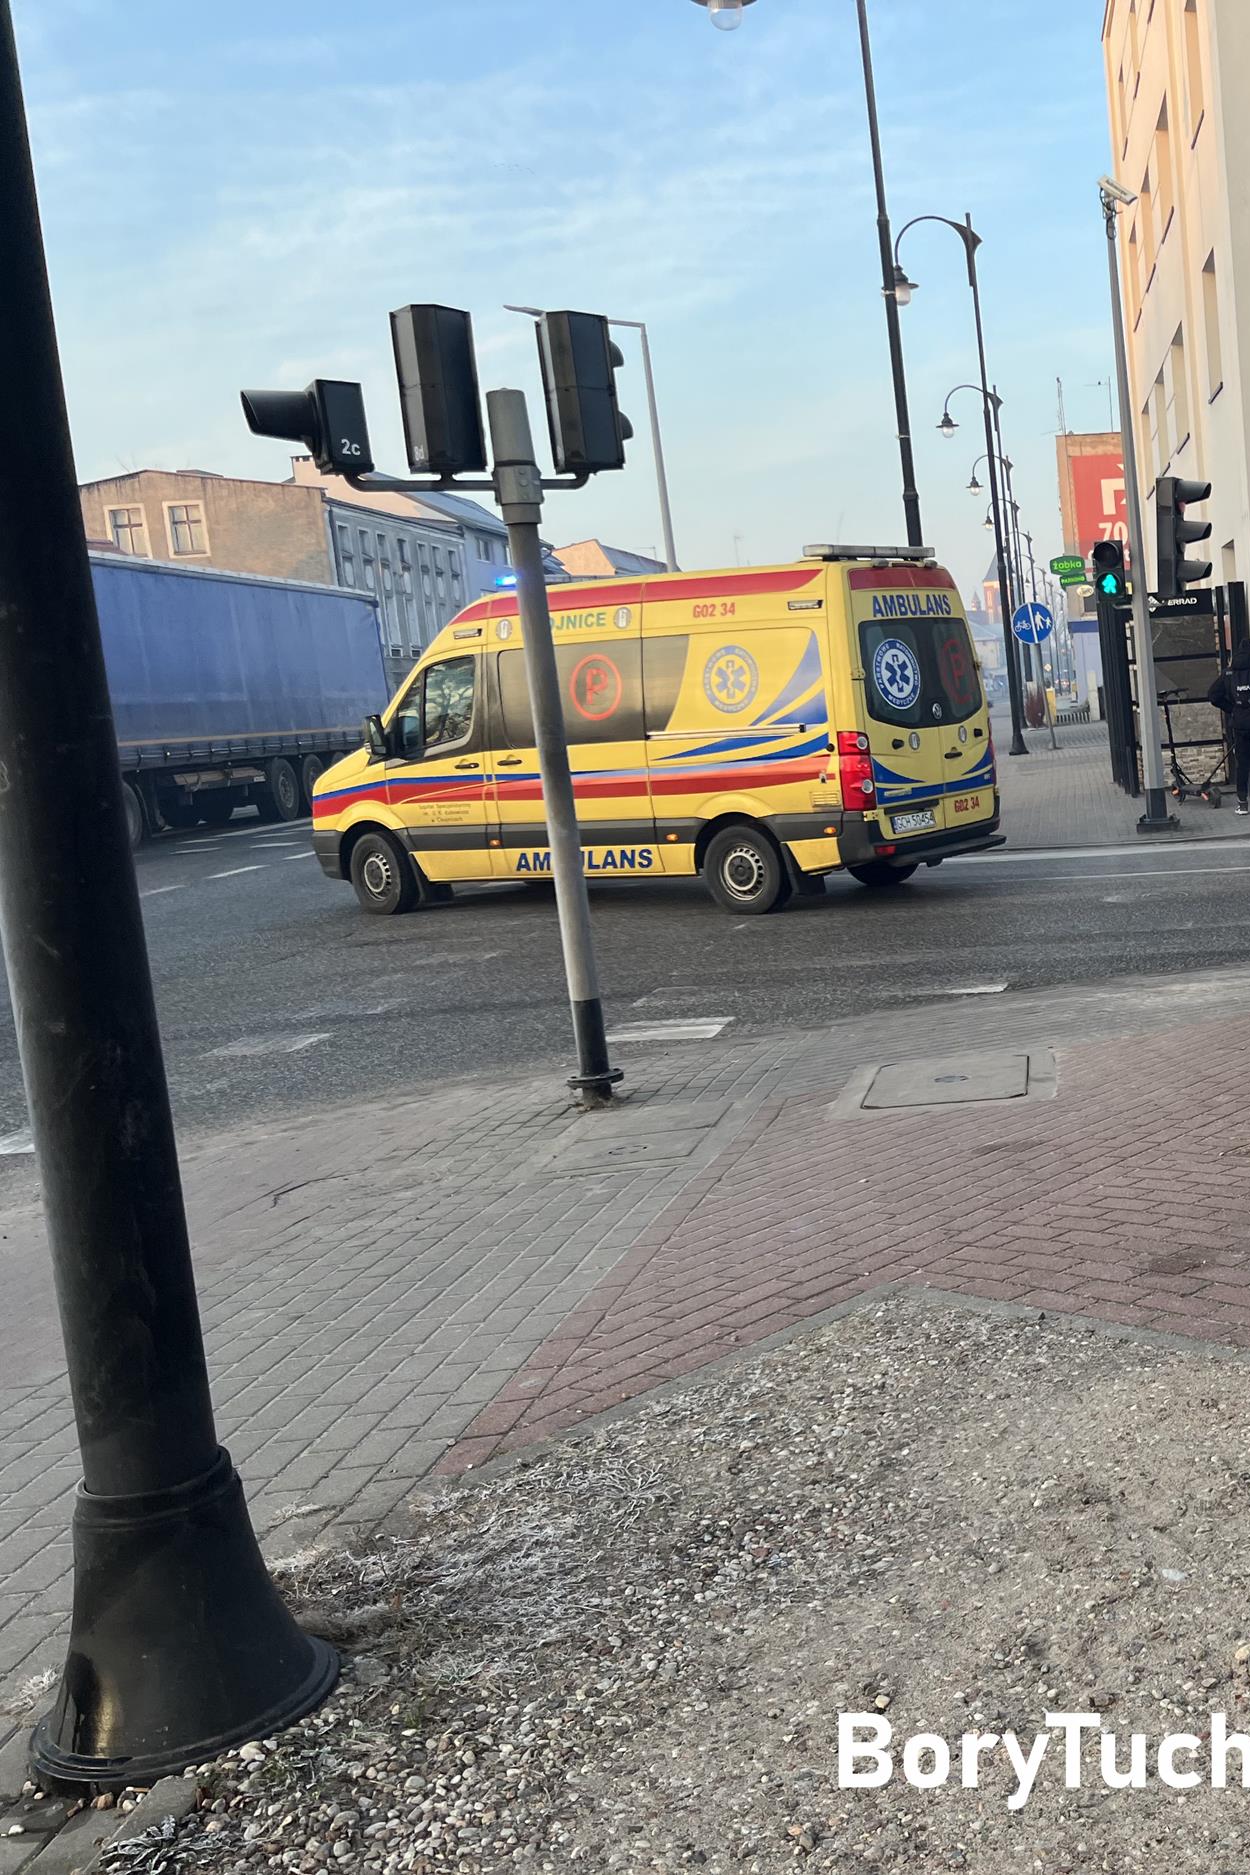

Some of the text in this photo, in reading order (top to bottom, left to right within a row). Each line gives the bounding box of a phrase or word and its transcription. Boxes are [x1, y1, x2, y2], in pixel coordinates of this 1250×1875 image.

[341, 438, 361, 456] 2c
[720, 602, 736, 616] 34
[872, 593, 952, 617] AMBULANS
[970, 795, 980, 810] 34
[515, 848, 654, 872] AMLANS
